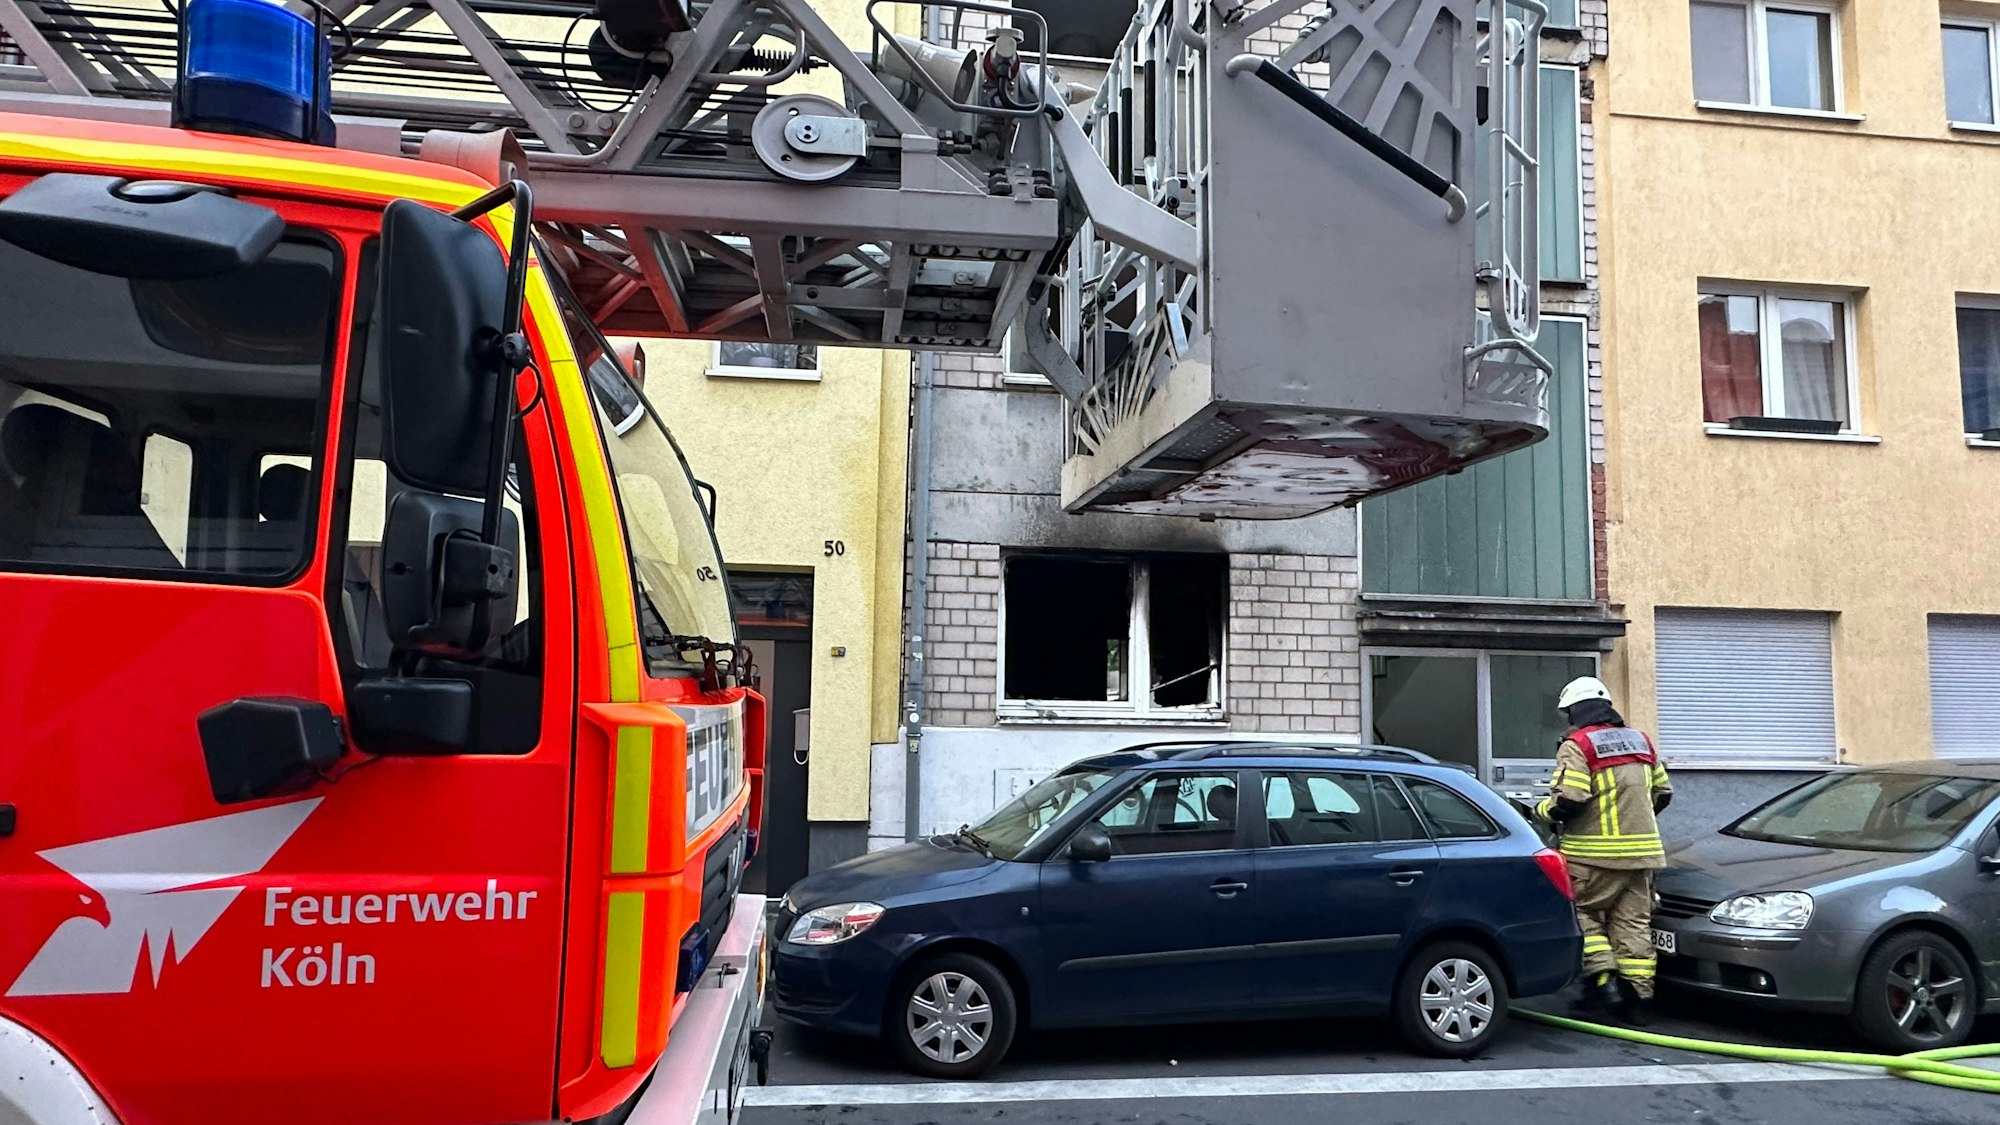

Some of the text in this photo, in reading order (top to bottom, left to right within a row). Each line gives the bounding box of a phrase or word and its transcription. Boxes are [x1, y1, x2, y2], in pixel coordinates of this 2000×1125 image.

[824, 540, 845, 557] 50
[264, 879, 538, 927] Feuerwehr
[1651, 930, 1673, 949] 868
[260, 942, 376, 988] Köln
